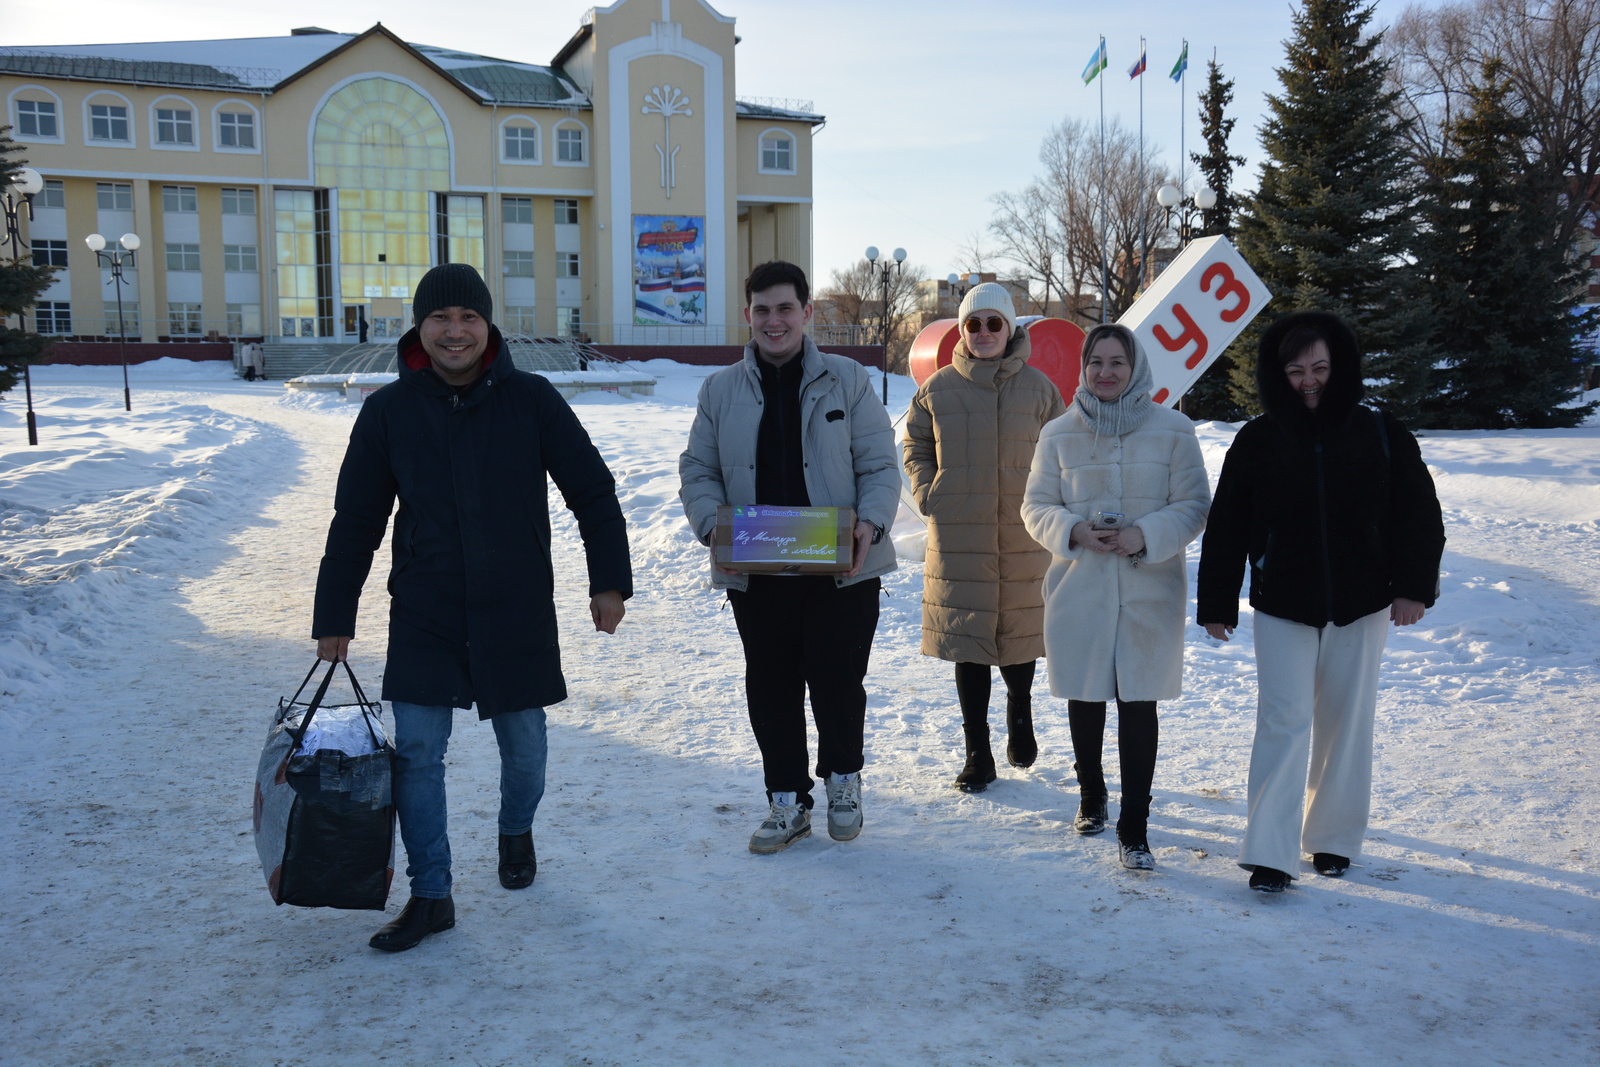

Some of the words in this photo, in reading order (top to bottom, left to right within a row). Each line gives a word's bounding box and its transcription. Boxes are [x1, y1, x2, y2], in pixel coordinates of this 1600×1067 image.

[1151, 261, 1251, 405] УЗ
[735, 530, 750, 545] Из
[751, 531, 797, 547] Мелеуза
[791, 544, 835, 555] любовью
